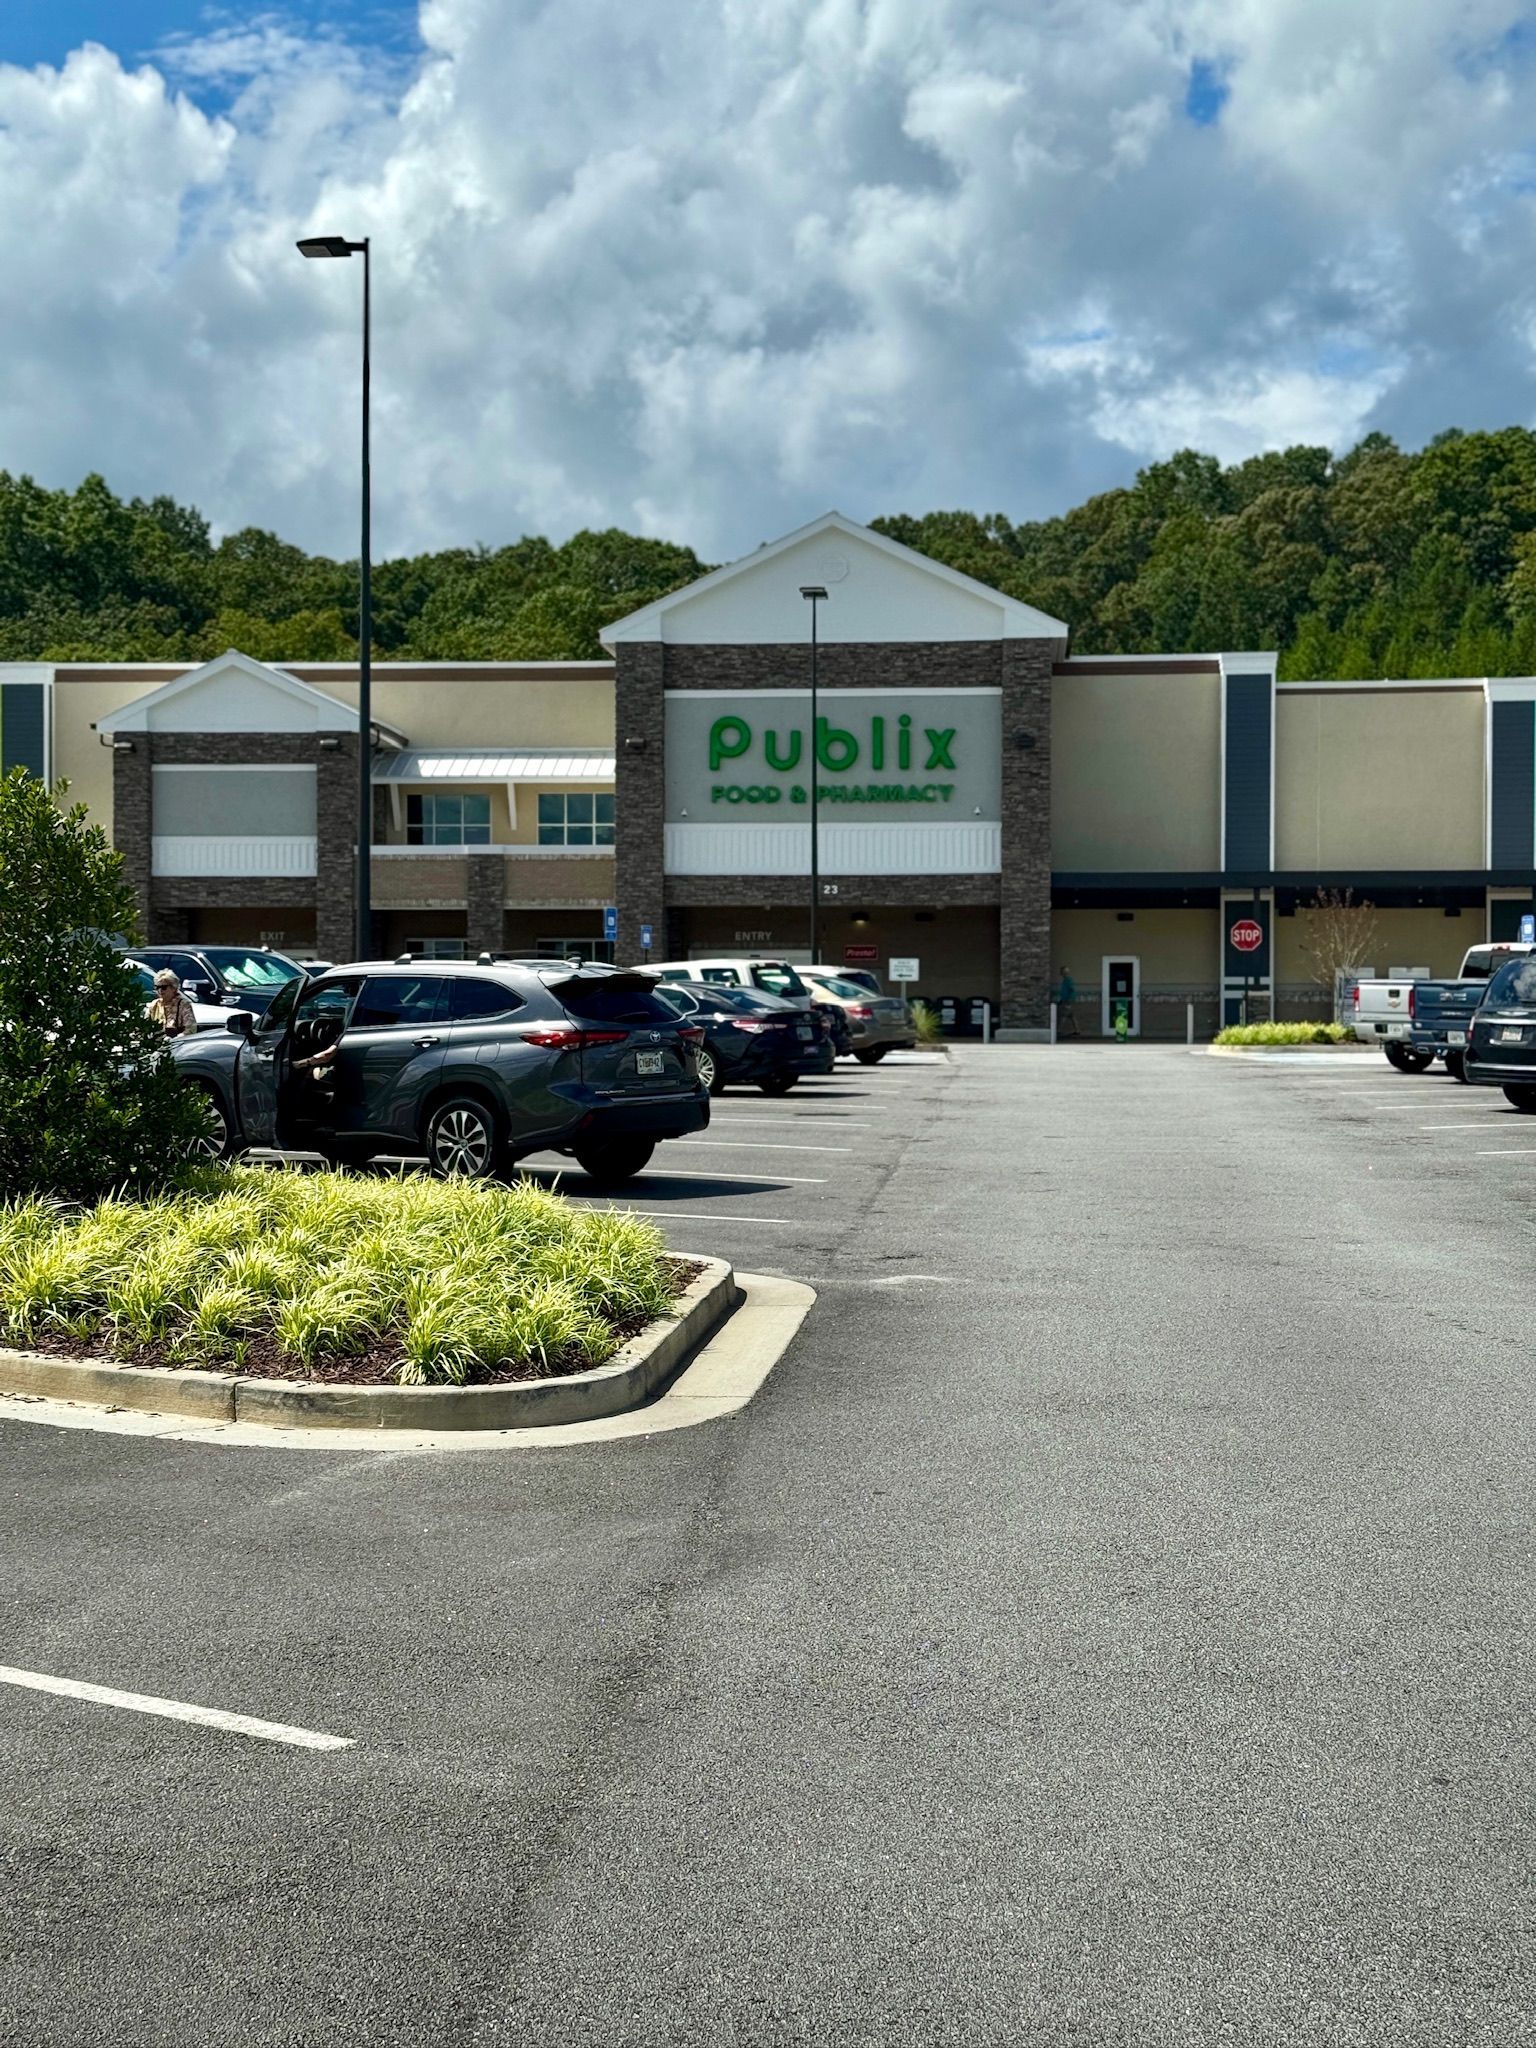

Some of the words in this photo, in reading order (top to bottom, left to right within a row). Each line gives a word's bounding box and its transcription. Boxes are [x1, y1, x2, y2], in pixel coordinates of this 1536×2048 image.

[709, 714, 957, 772] Publix
[711, 785, 781, 804] FOOD
[790, 785, 807, 804] &
[816, 783, 954, 804] PHARMACY
[823, 884, 839, 895] 23
[260, 931, 285, 941] EXIT
[735, 931, 772, 941] ENTRY
[1233, 929, 1260, 941] STOP
